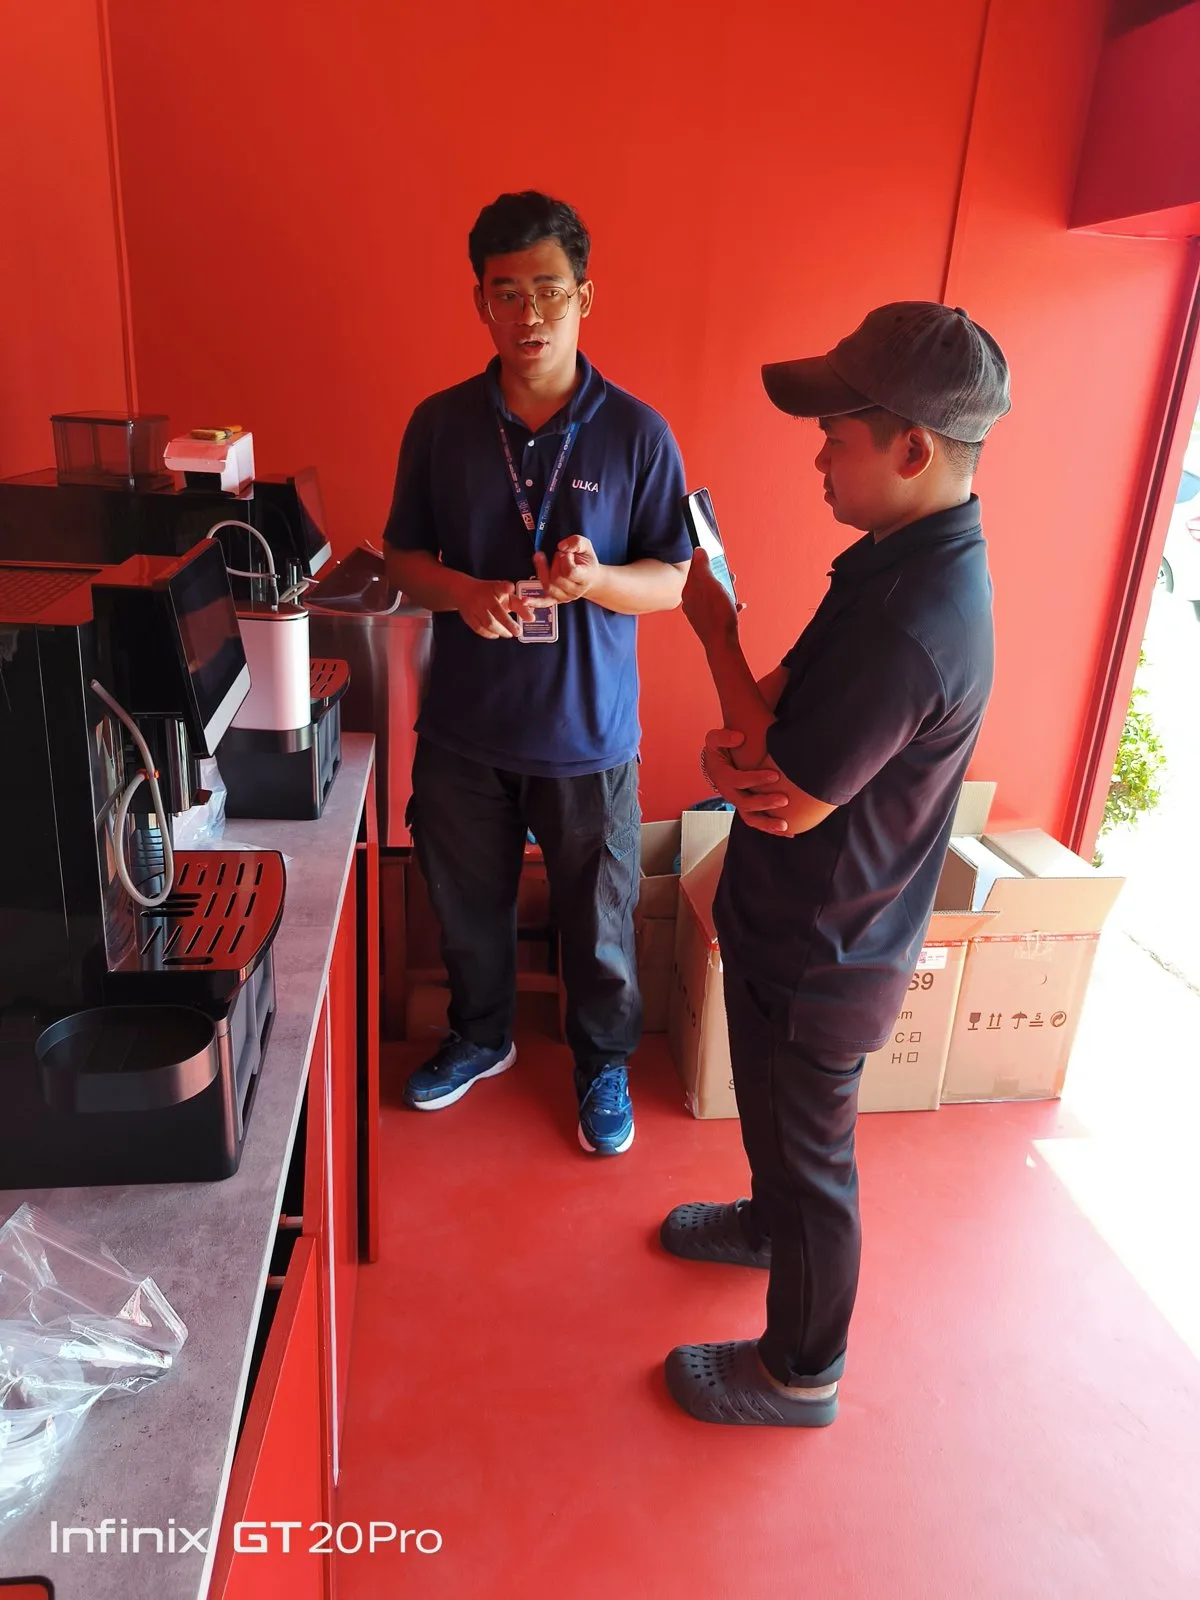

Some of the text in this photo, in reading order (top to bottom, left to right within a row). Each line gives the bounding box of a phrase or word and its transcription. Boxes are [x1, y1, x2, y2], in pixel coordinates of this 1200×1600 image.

[572, 479, 599, 493] ULKA
[894, 1032, 905, 1043] C
[891, 1052, 902, 1064] H
